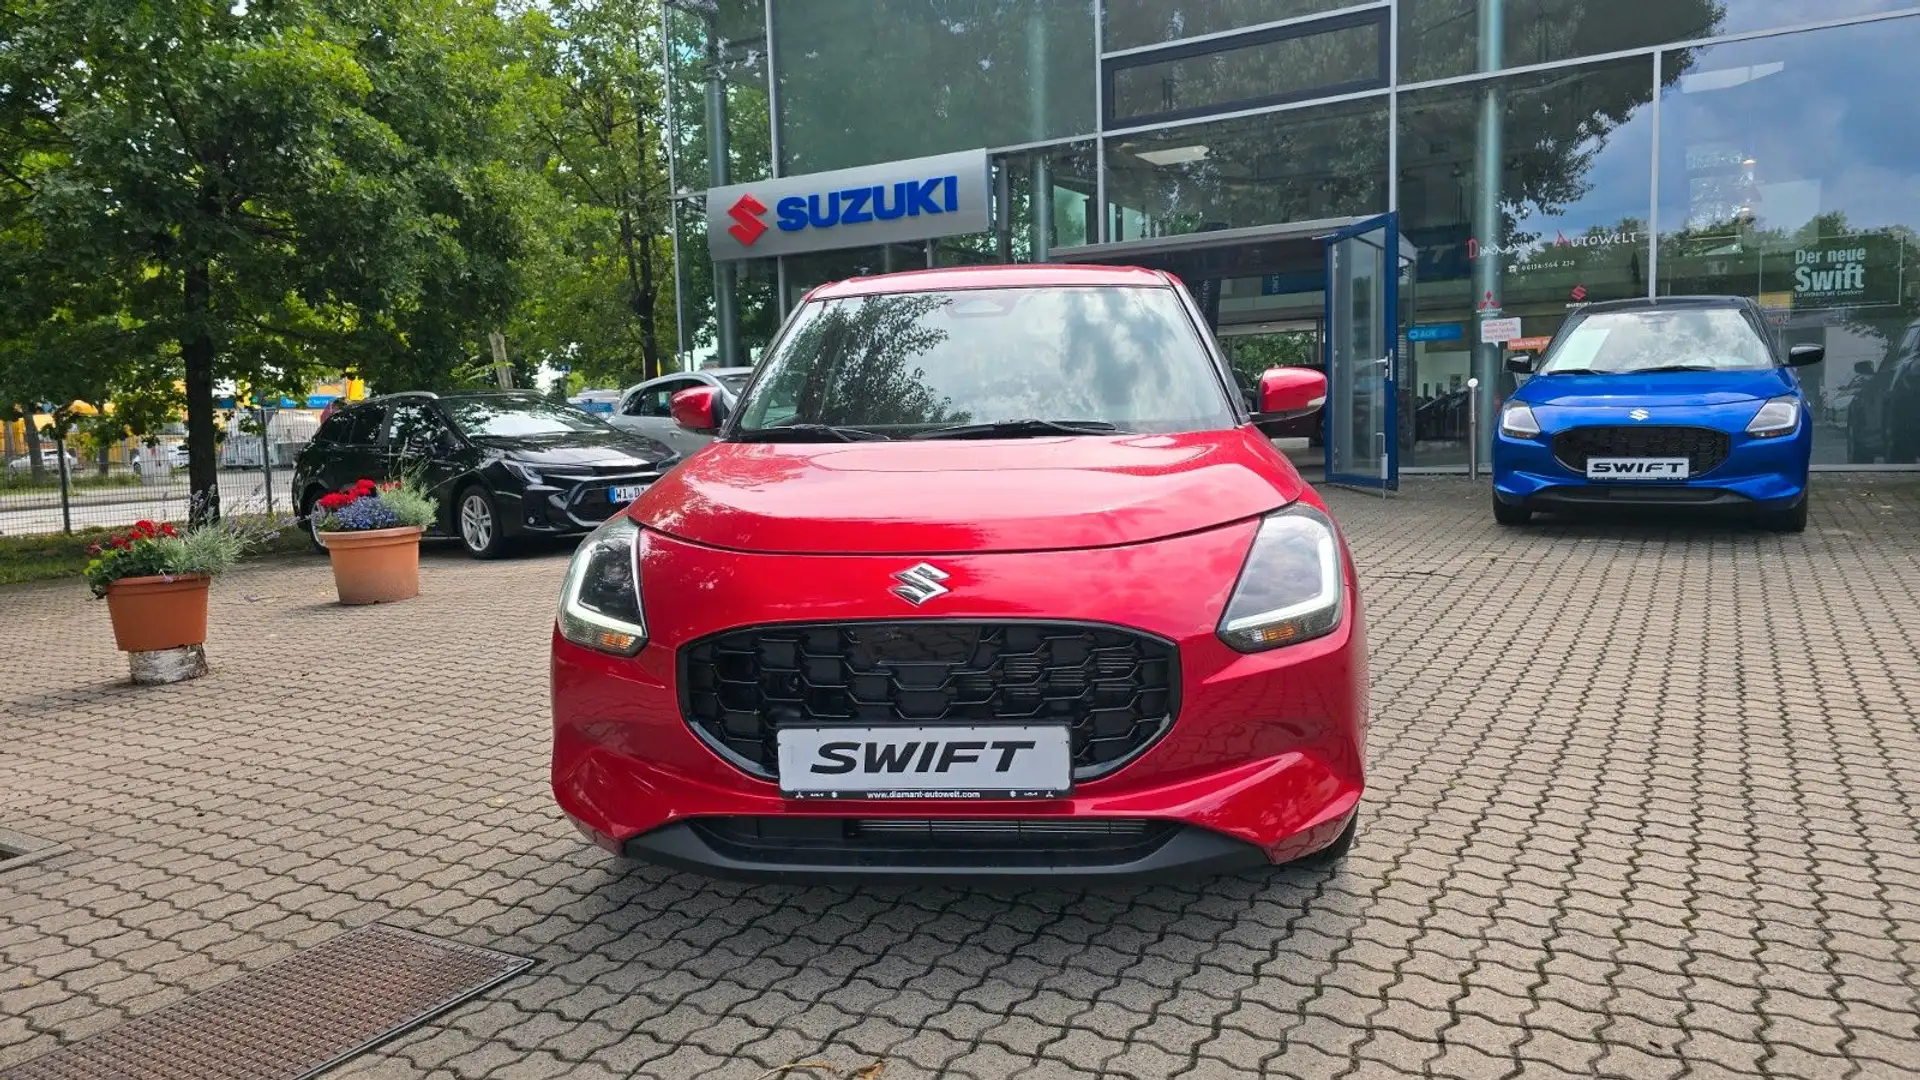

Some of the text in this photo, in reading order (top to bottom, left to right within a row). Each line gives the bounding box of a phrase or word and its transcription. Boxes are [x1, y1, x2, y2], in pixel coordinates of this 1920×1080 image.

[777, 176, 958, 232] SUZUKI
[1795, 247, 1866, 265] Der neue
[1794, 262, 1865, 292] Swift
[1592, 463, 1684, 473] SWIFT
[810, 741, 1036, 774] SWIFT
[867, 789, 980, 799] www.diamant-autowelt.com
